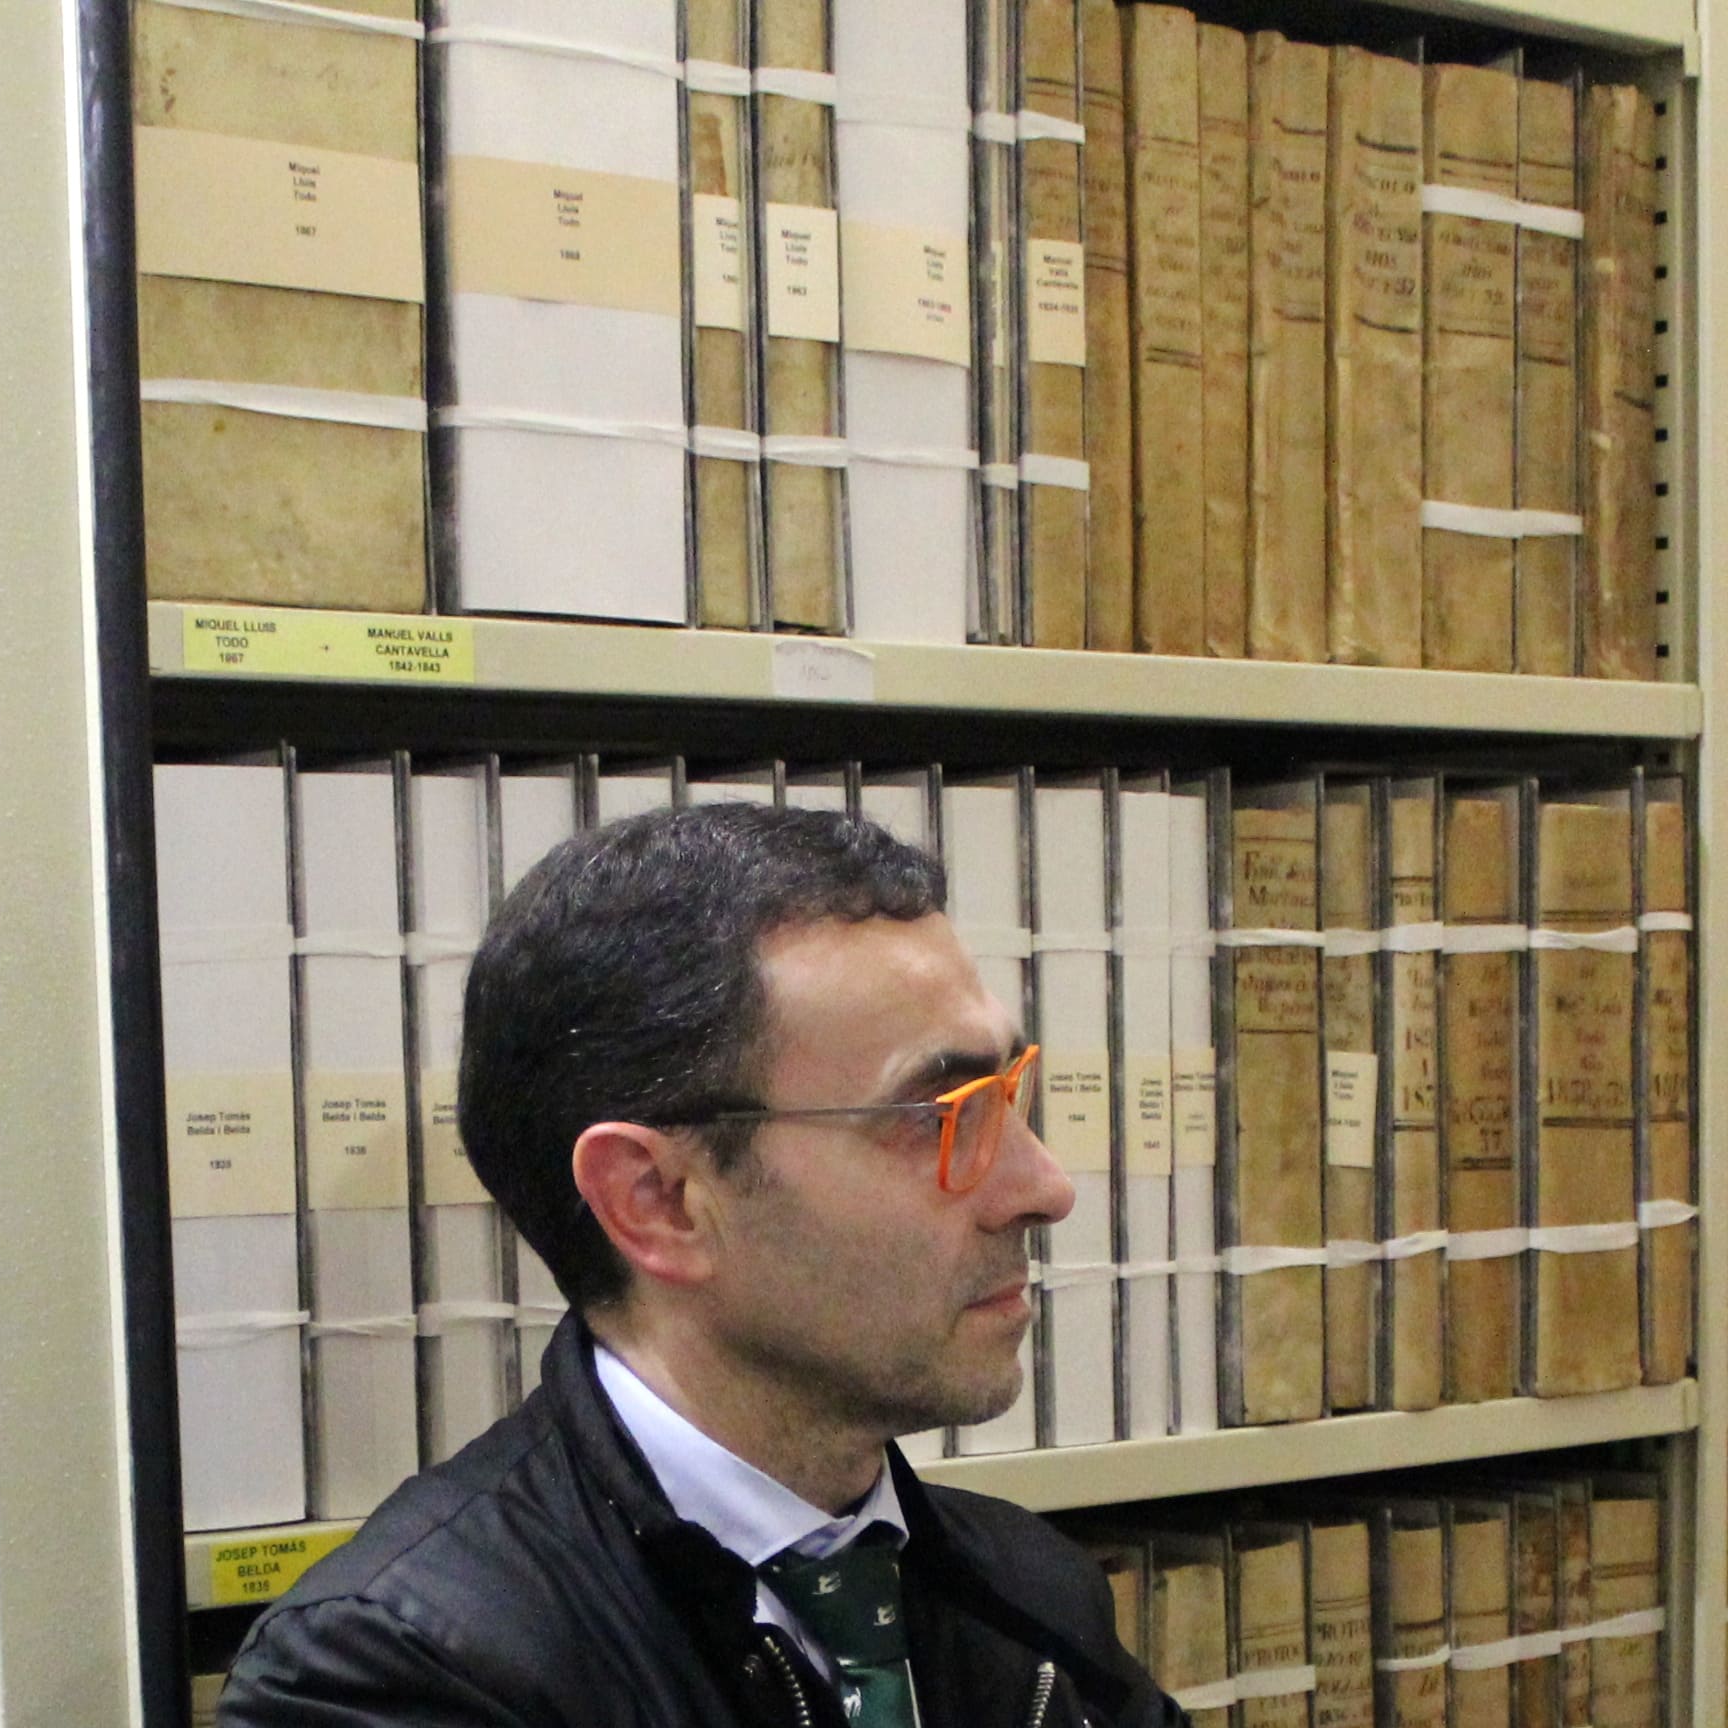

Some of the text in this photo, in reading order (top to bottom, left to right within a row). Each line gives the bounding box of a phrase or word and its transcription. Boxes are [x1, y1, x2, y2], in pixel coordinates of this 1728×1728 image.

[195, 617, 239, 631] MIQUEL
[216, 635, 249, 649] TODO
[367, 627, 453, 643] MANUEL VALLS
[375, 644, 450, 658] CANTAVELLA
[321, 1099, 352, 1111] Josep
[186, 1111, 216, 1124] Josep
[322, 1111, 351, 1122] Belda
[359, 1111, 386, 1122] Belda
[187, 1125, 215, 1136] Belda
[223, 1124, 251, 1135] Belda
[216, 1546, 258, 1563] JOSEP
[238, 1562, 281, 1578] BELDA
